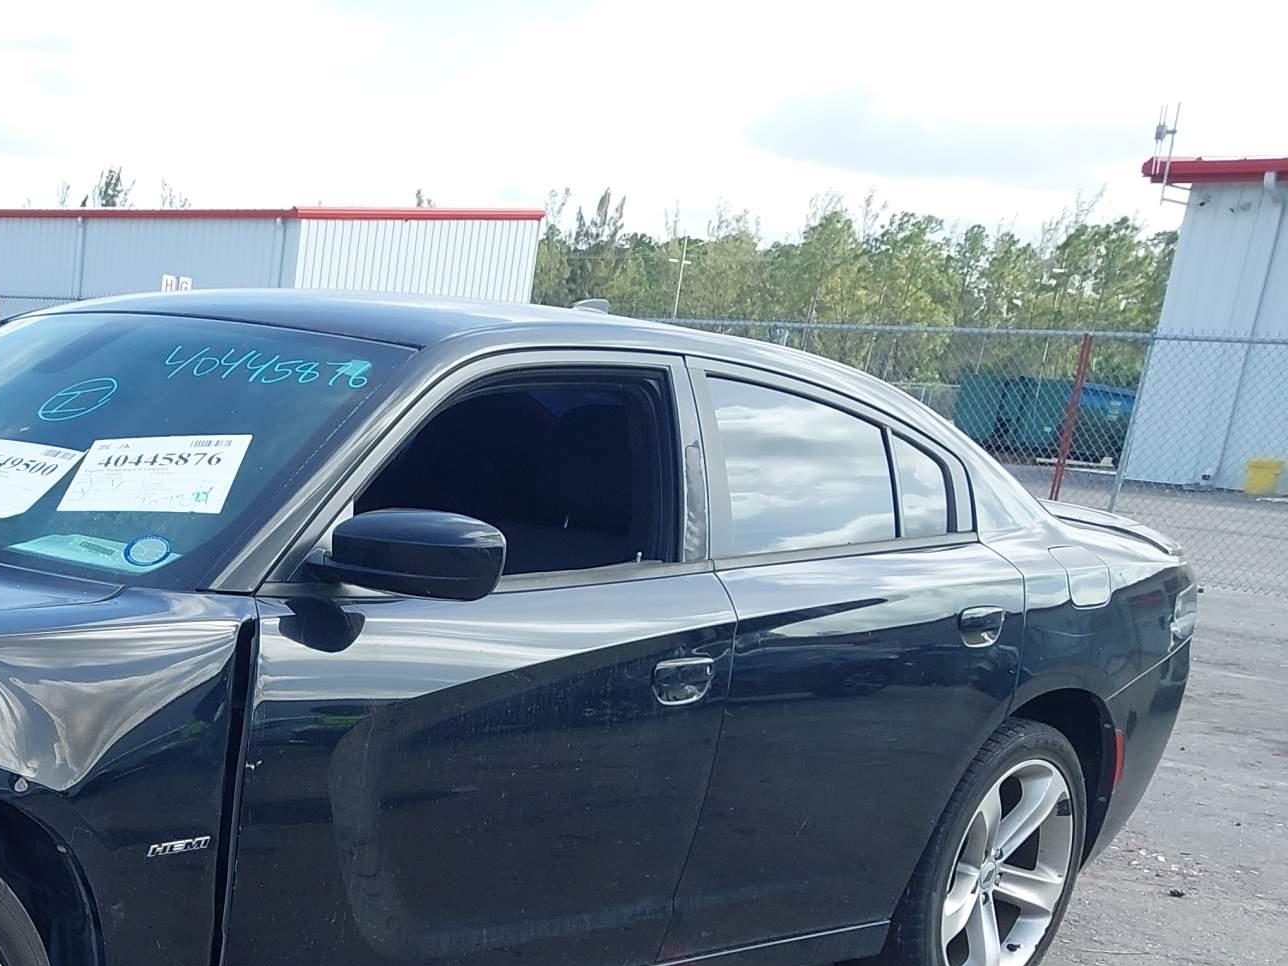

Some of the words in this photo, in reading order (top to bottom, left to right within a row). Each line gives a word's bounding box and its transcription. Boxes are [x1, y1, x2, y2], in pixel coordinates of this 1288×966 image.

[164, 345, 373, 388] 40445876
[98, 451, 225, 468] 40445876
[146, 835, 211, 857] HEMI
